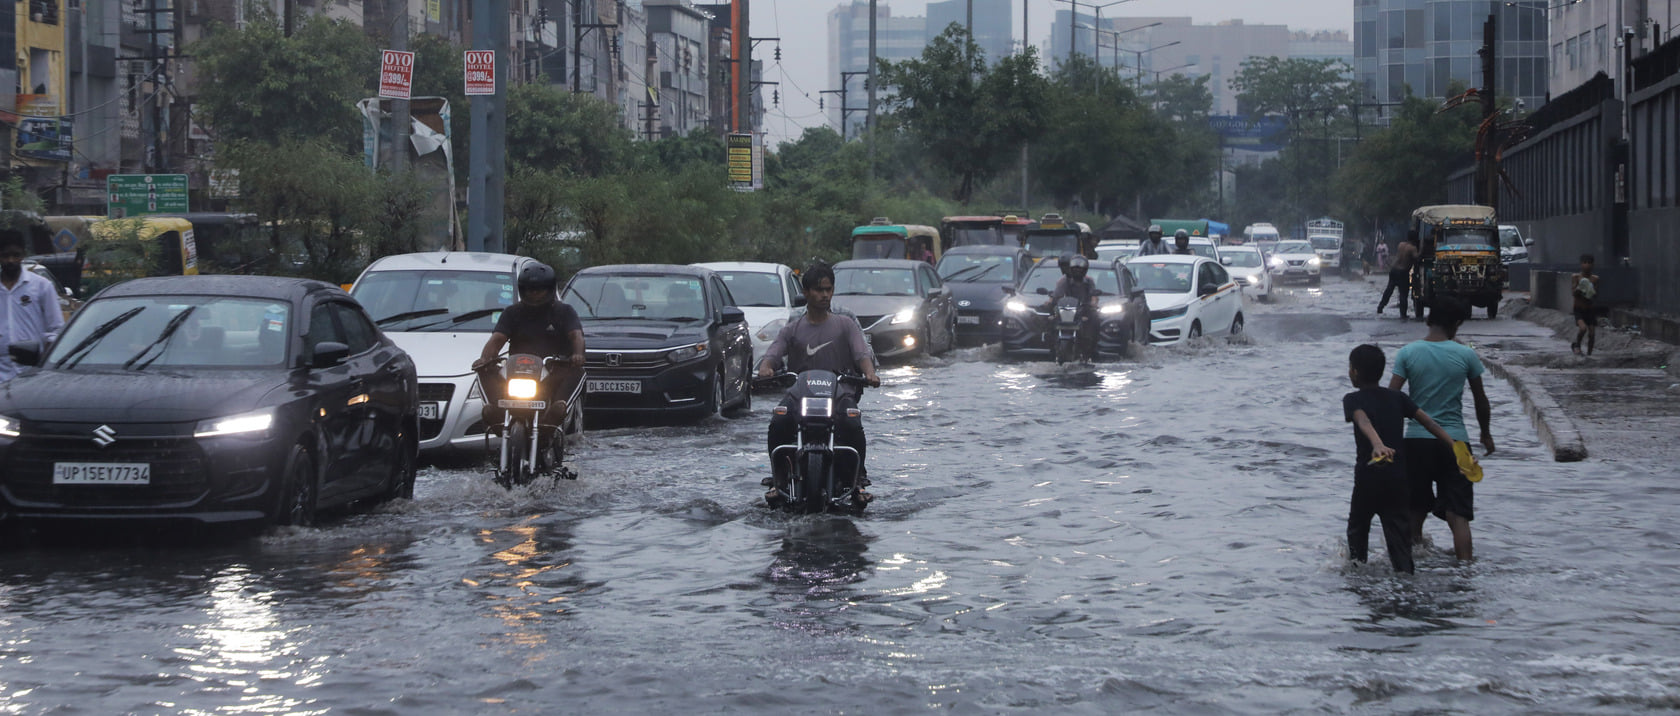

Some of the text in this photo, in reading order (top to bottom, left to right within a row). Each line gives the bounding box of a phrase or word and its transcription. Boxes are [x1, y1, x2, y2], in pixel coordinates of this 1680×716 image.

[384, 52, 412, 67] OYO
[467, 52, 493, 64] OYO
[384, 64, 410, 73] HOTEL
[589, 382, 640, 392] DL3CCX5667
[806, 379, 832, 387] YADAV
[62, 466, 149, 481] UP15EY7734
